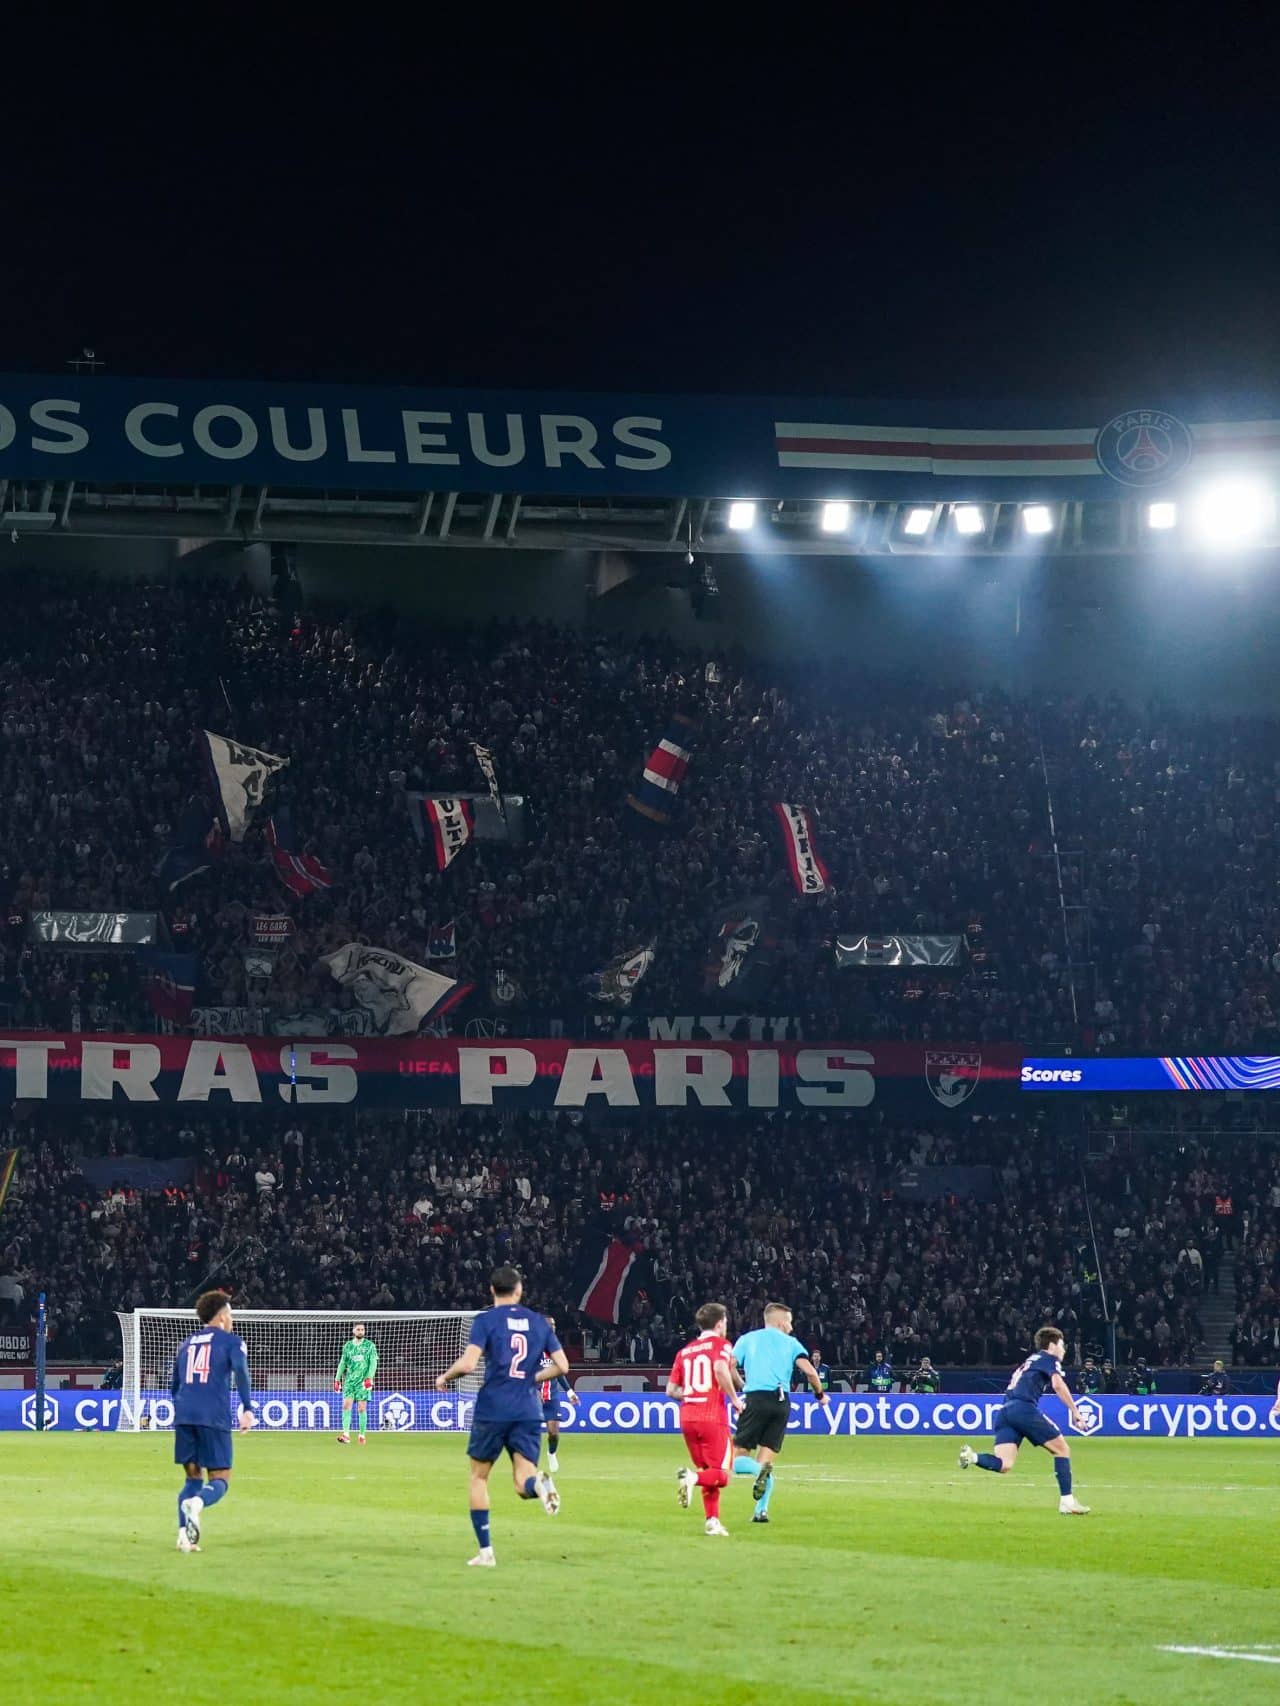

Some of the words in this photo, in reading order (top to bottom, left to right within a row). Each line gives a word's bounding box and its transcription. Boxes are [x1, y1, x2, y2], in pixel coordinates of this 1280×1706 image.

[124, 402, 671, 471] COULEURS
[457, 1047, 876, 1108] PARIS
[1021, 1066, 1082, 1083] Scores
[185, 1344, 212, 1384] 14
[508, 1333, 528, 1379] 2
[683, 1354, 713, 1396] 10
[74, 1398, 331, 1431] crypcom
[430, 1399, 680, 1430] cro.com
